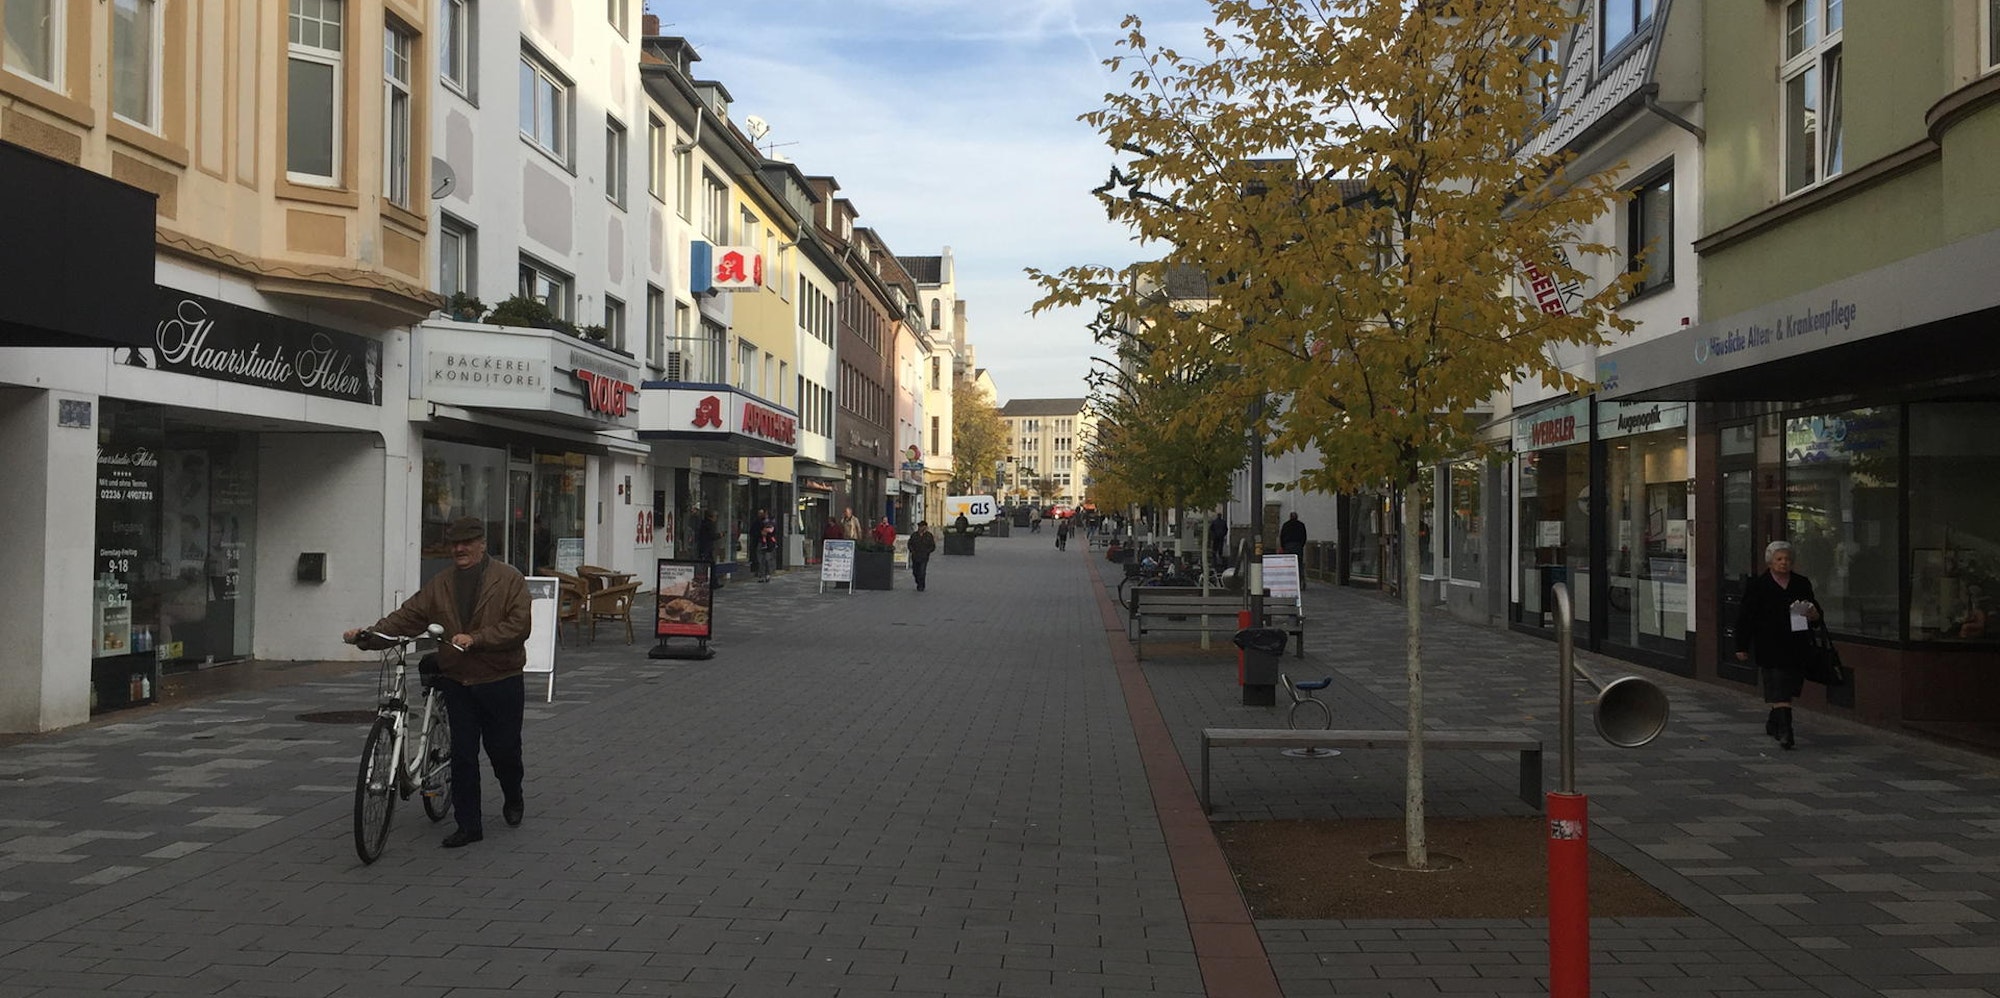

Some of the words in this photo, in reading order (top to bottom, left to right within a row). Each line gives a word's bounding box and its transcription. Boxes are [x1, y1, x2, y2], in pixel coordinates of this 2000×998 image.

[1747, 324, 1773, 348] Alten-
[1776, 319, 1784, 341] &
[1786, 299, 1857, 338] Krankenpflege
[155, 299, 292, 383] Haarstudio
[295, 332, 361, 395] Helen
[434, 370, 542, 387] KONDITOREI
[576, 367, 636, 418] VOIGT
[742, 402, 797, 447] APOTHEKE
[1532, 415, 1576, 447] WEIBELER
[1617, 404, 1661, 433] Augenoptik
[970, 502, 990, 515] GLS
[108, 559, 130, 573] 9-18
[107, 592, 129, 608] 9-17
